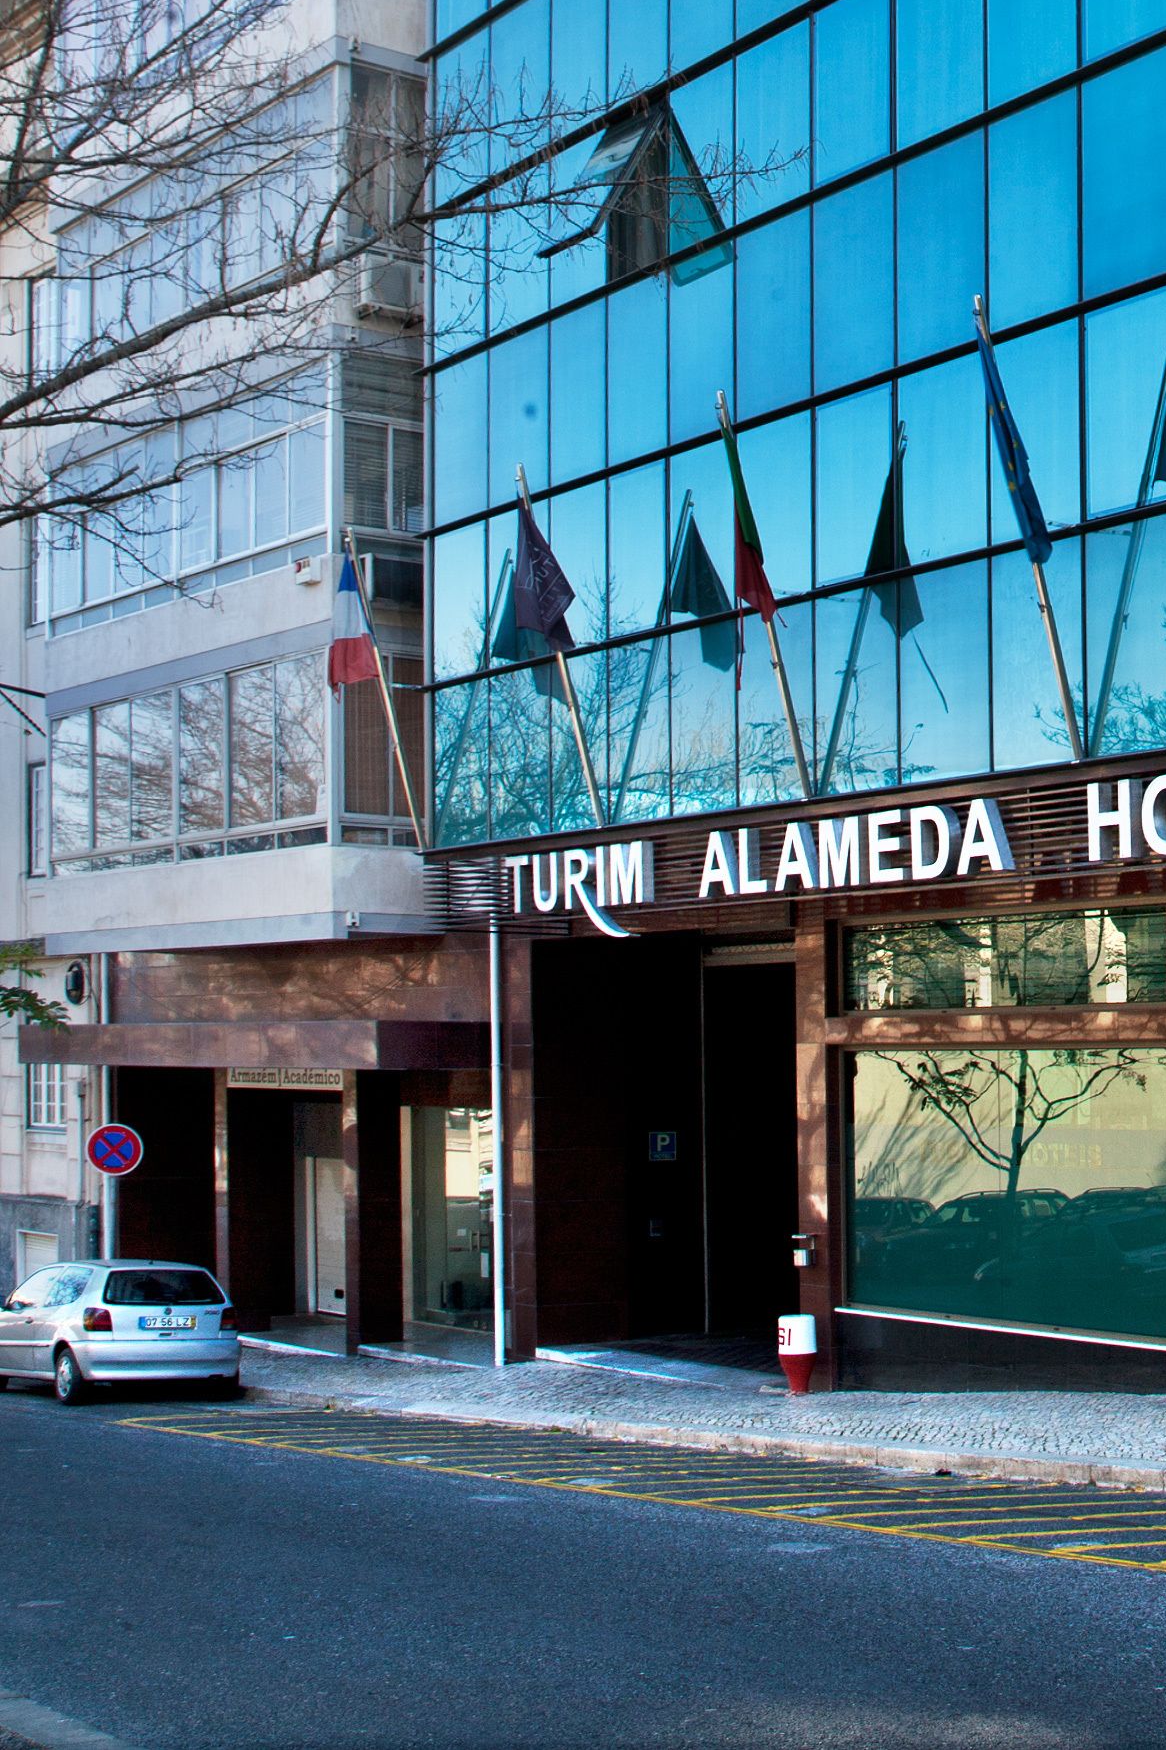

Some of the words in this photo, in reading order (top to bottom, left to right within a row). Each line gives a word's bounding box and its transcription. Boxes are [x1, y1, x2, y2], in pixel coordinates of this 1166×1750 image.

[505, 841, 648, 938] TURIM
[699, 797, 1012, 898] ALAMEDA
[230, 1068, 277, 1084] Armazém
[282, 1068, 341, 1085] Académico
[657, 1135, 670, 1151] P
[176, 1317, 190, 1327] LZ
